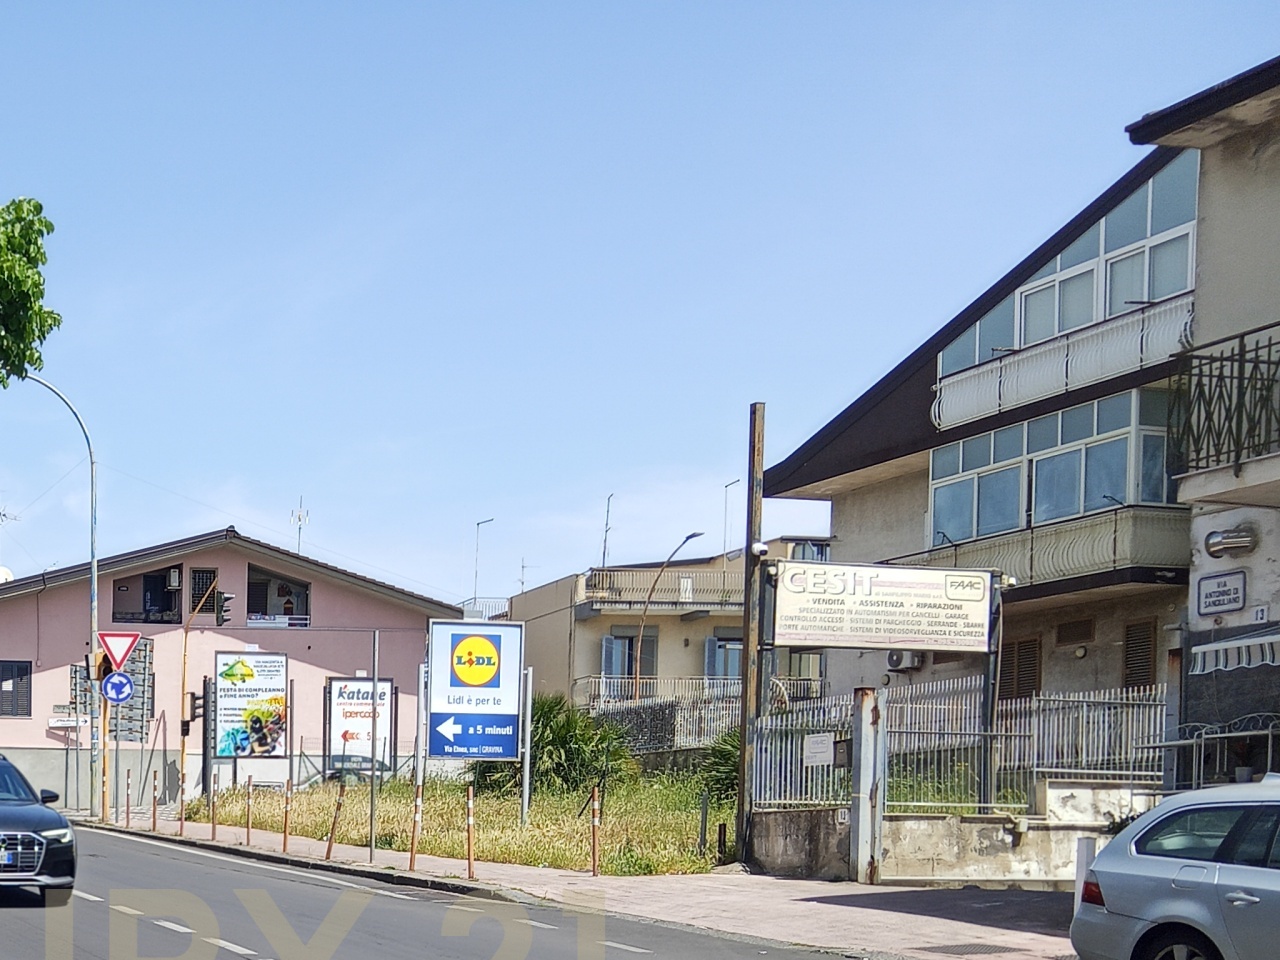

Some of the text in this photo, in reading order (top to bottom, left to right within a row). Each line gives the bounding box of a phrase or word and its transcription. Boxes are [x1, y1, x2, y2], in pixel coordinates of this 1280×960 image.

[783, 567, 879, 597] CESIT
[950, 580, 981, 590] FAAC
[1217, 580, 1227, 588] VIA
[812, 598, 963, 611] VENDITA ASSISTENZA RIPARAZIONI
[798, 607, 845, 615] SPECIALIZZATO
[854, 609, 898, 617] AUTOMATISMI
[1254, 608, 1265, 621] 13
[780, 615, 817, 623] CONTROLLO
[819, 616, 845, 624] ACCESSI
[883, 619, 922, 627] PARCHEGGIO
[927, 620, 958, 628] SERRANDE
[800, 624, 844, 632] AUTOMATICHE
[883, 627, 947, 637] VIDEOSORVEGLIANZA
[447, 695, 502, 706] Lidl è per te
[468, 725, 513, 735] a 5 minuti
[366, 731, 372, 741] 5
[444, 745, 452, 753] Via
